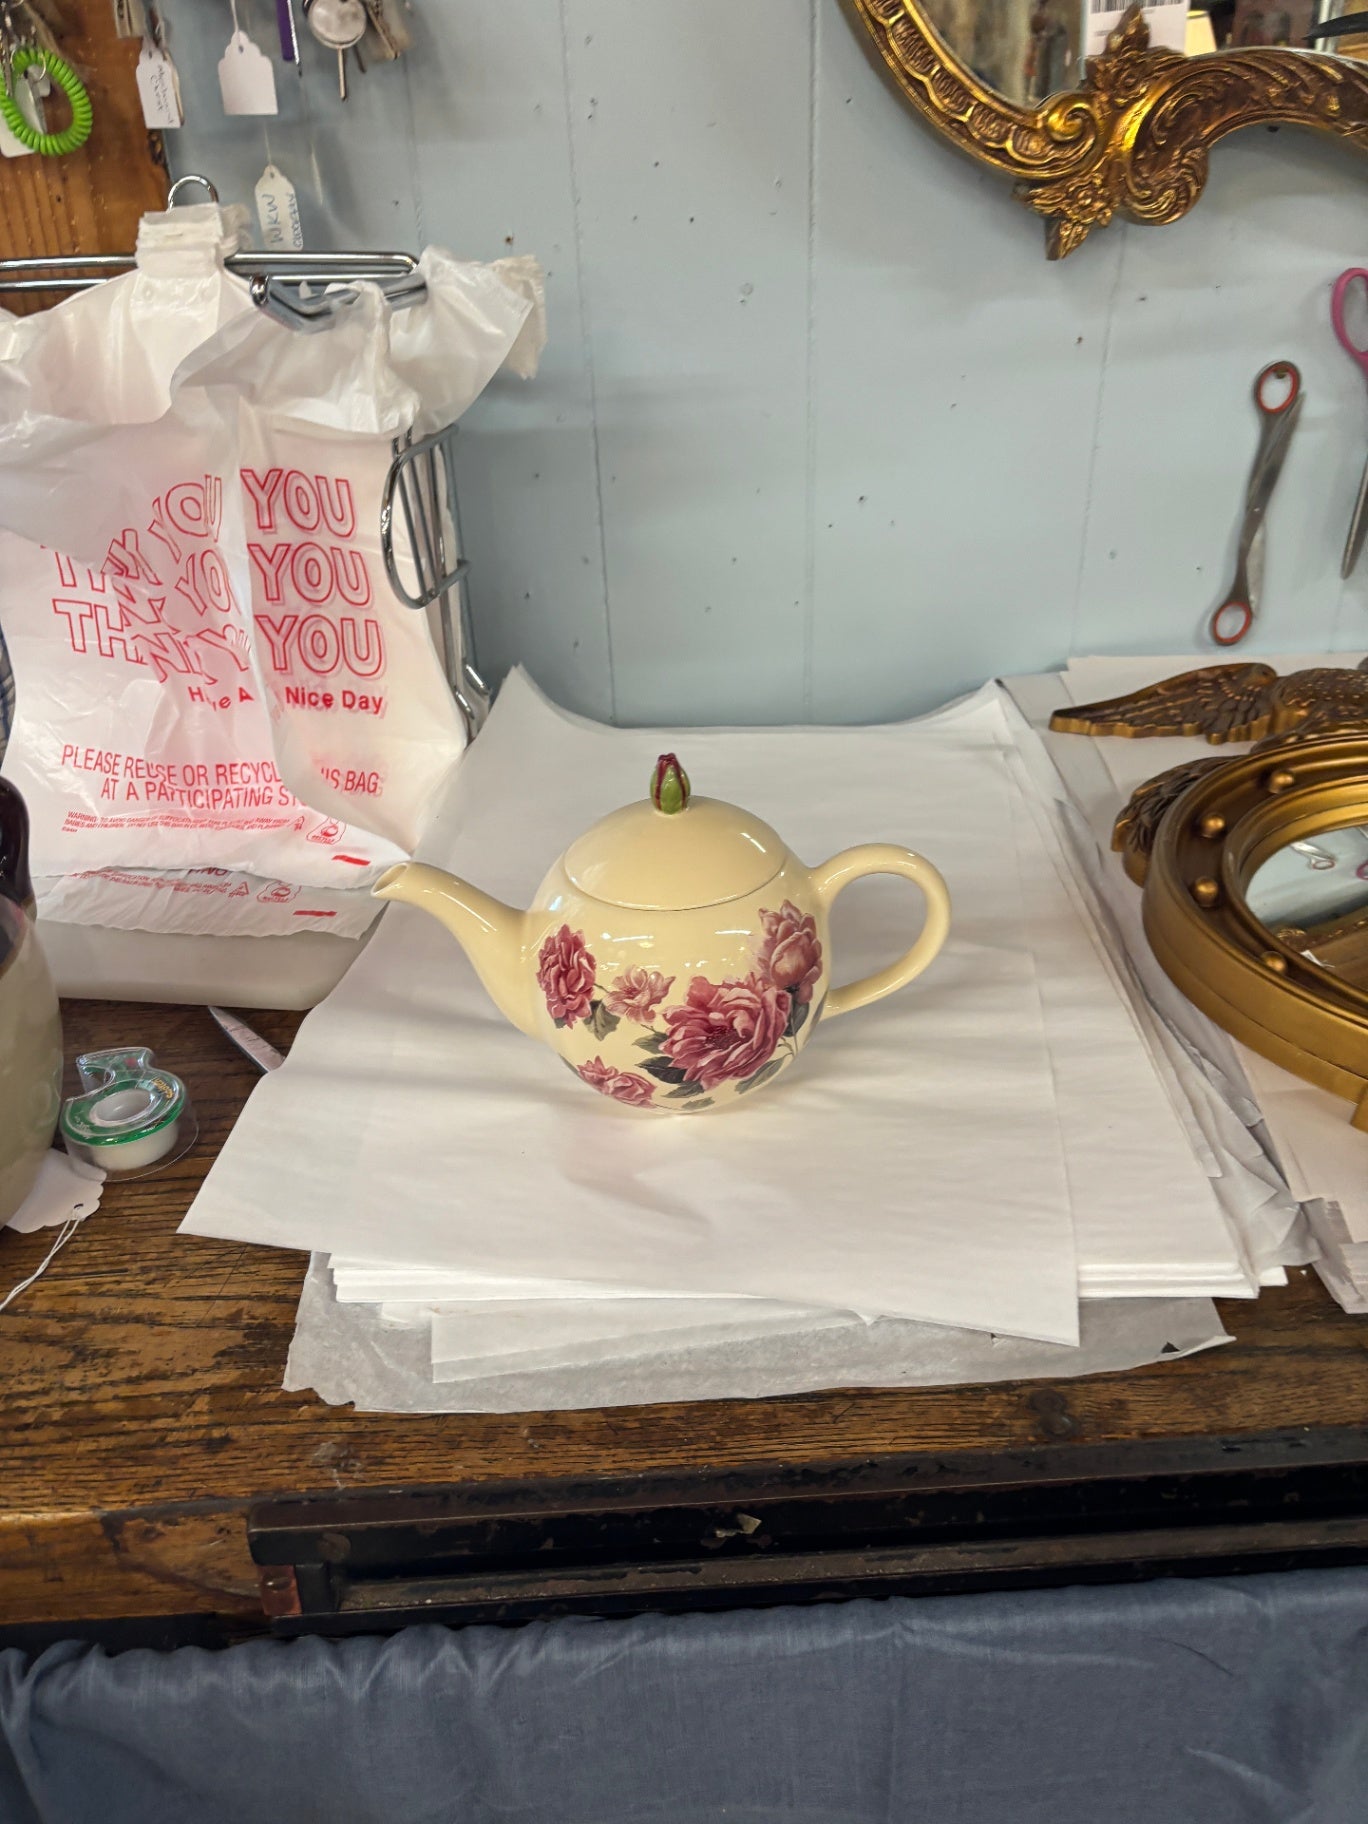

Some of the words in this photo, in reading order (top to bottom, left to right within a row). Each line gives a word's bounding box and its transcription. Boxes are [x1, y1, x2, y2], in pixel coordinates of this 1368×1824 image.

[240, 468, 355, 538] YOU
[174, 549, 242, 616] YO
[247, 541, 370, 606] YOU
[254, 614, 382, 676] YOU
[188, 686, 232, 711] He
[238, 686, 254, 702] A
[285, 686, 334, 708] Nice
[341, 690, 384, 715] Day
[61, 744, 122, 776] PLEASE
[124, 756, 178, 786] REUSE
[182, 764, 209, 787] OR
[215, 760, 283, 785] RECYCL
[320, 768, 341, 789] IS
[344, 770, 379, 793] BAG
[101, 777, 119, 800] AT
[126, 781, 139, 801] A
